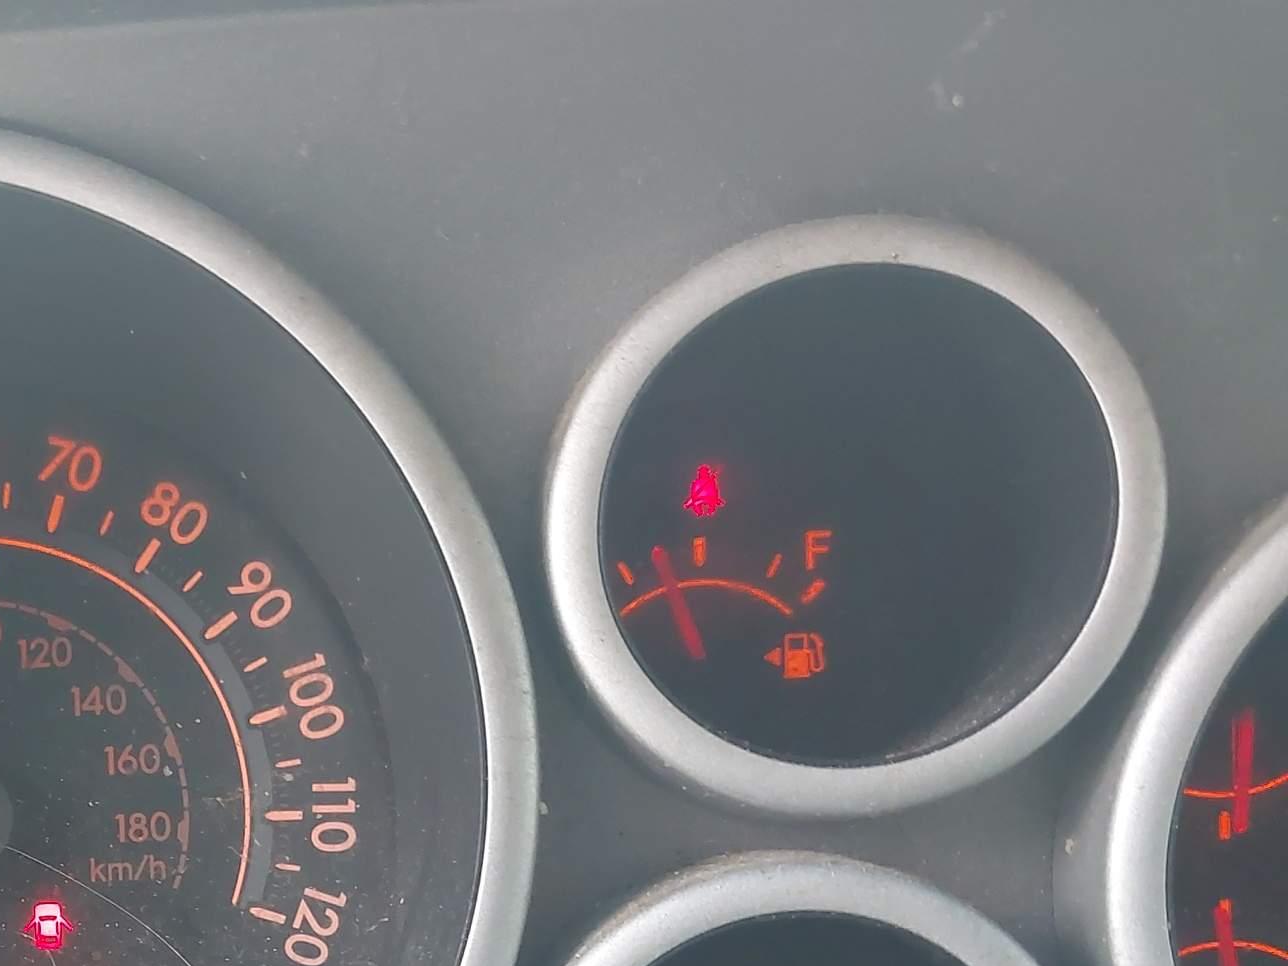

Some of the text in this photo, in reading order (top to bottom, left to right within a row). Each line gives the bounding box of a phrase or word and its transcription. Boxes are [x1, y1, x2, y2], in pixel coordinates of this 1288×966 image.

[37, 436, 102, 493] 70
[139, 481, 208, 546] 80
[805, 529, 832, 570] F
[226, 559, 292, 630] 90
[18, 636, 73, 671] 120
[71, 683, 126, 717] 140
[282, 652, 344, 742] 100
[104, 743, 161, 776] 160
[114, 810, 171, 843] 180
[310, 776, 357, 853] 110
[89, 853, 166, 883] km/h
